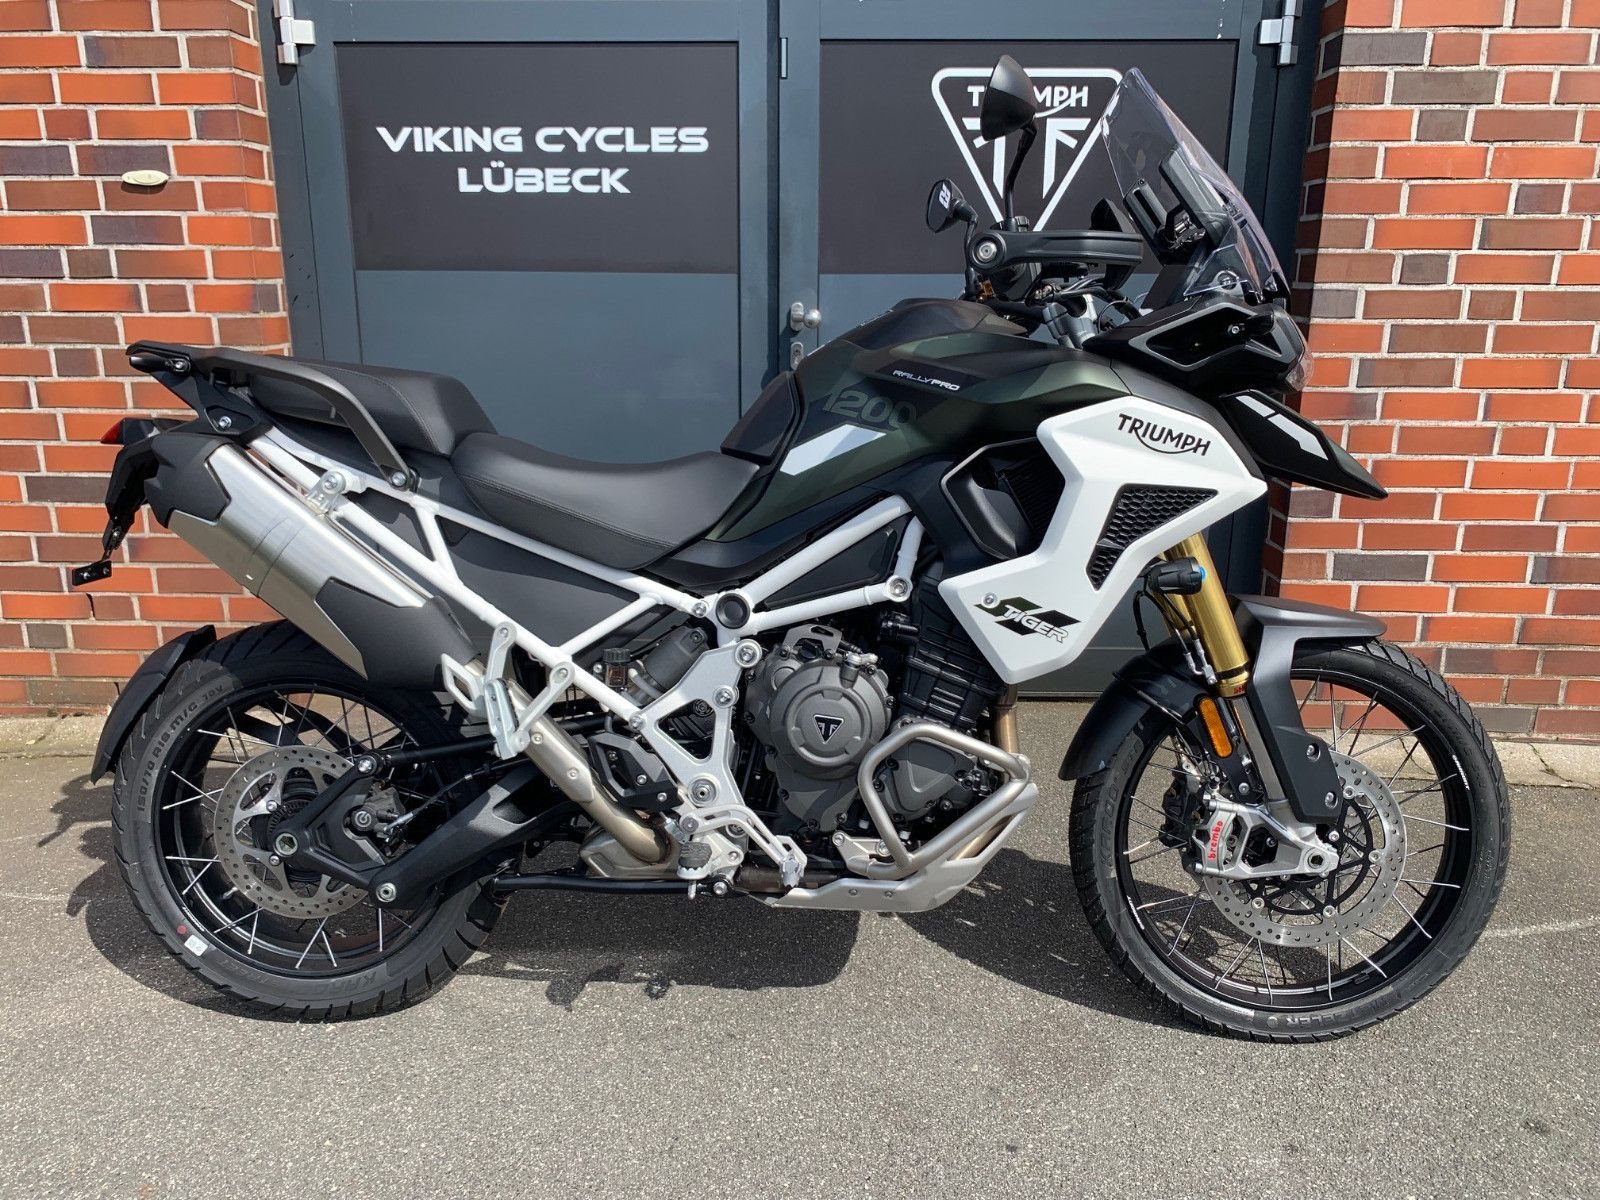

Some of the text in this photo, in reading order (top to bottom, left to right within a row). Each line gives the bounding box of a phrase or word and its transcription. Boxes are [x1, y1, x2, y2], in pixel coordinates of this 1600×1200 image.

[967, 85, 1089, 117] TMPH
[375, 126, 709, 153] VIKING CYCLES
[457, 160, 631, 194] LÜBECK
[822, 389, 917, 429] 1200
[1118, 413, 1211, 456] TRIUMPH
[1003, 604, 1069, 644] TIGER
[1208, 820, 1224, 860] brembo
